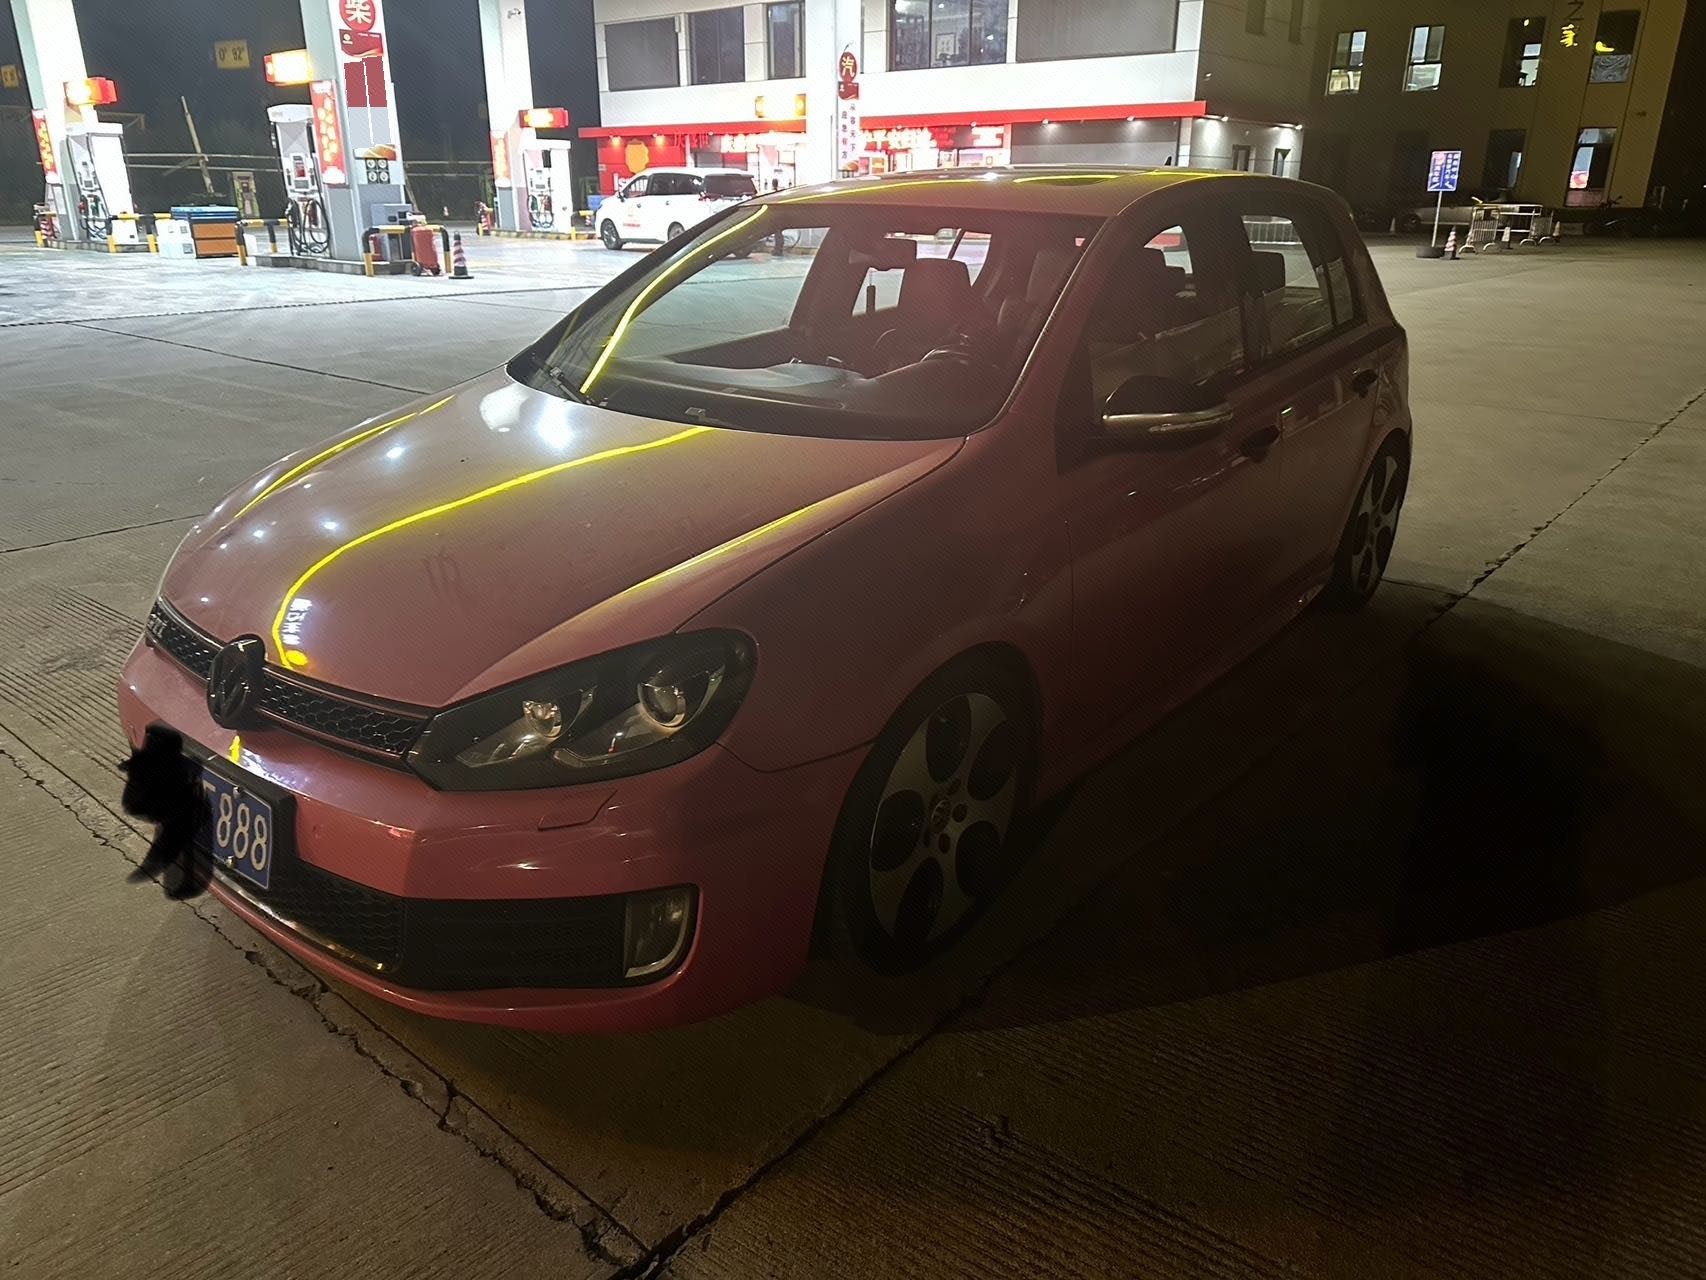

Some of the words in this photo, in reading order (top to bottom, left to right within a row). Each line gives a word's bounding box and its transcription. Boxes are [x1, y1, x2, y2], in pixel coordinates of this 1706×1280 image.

[344, 0, 372, 24] 柴
[841, 56, 855, 77] 汽
[202, 777, 268, 871] 888
